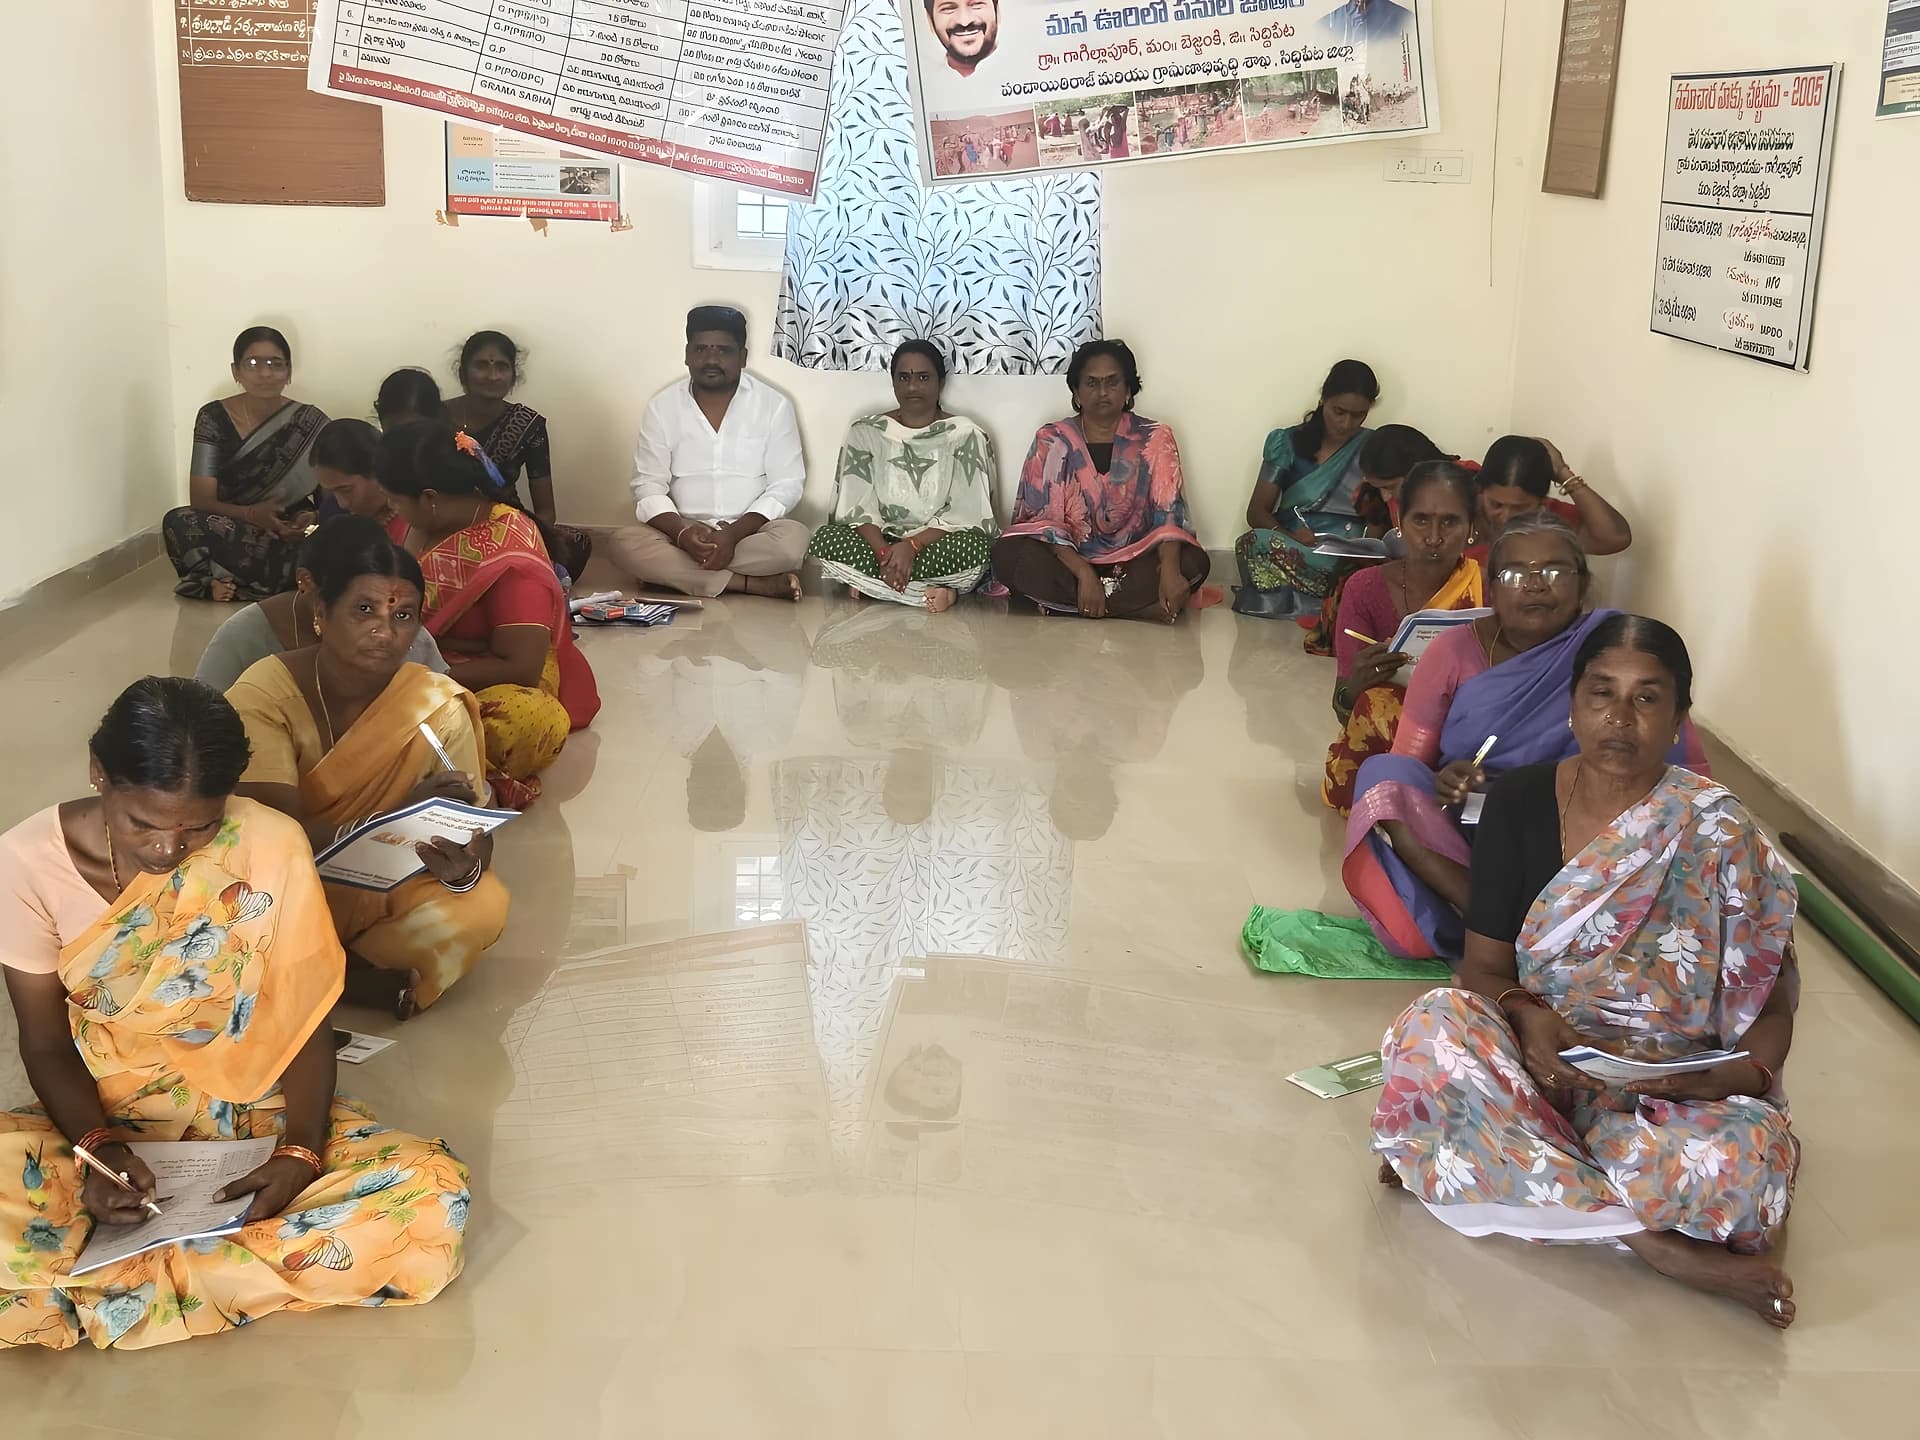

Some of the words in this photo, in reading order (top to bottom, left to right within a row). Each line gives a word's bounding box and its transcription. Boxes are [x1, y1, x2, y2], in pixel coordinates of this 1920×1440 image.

[1045, 10, 1088, 36] మన
[1093, 6, 1168, 31] ఊరిలో
[1098, 68, 1149, 85] మరియు
[480, 80, 516, 97] GRAMA
[1791, 76, 1824, 107] 2005
